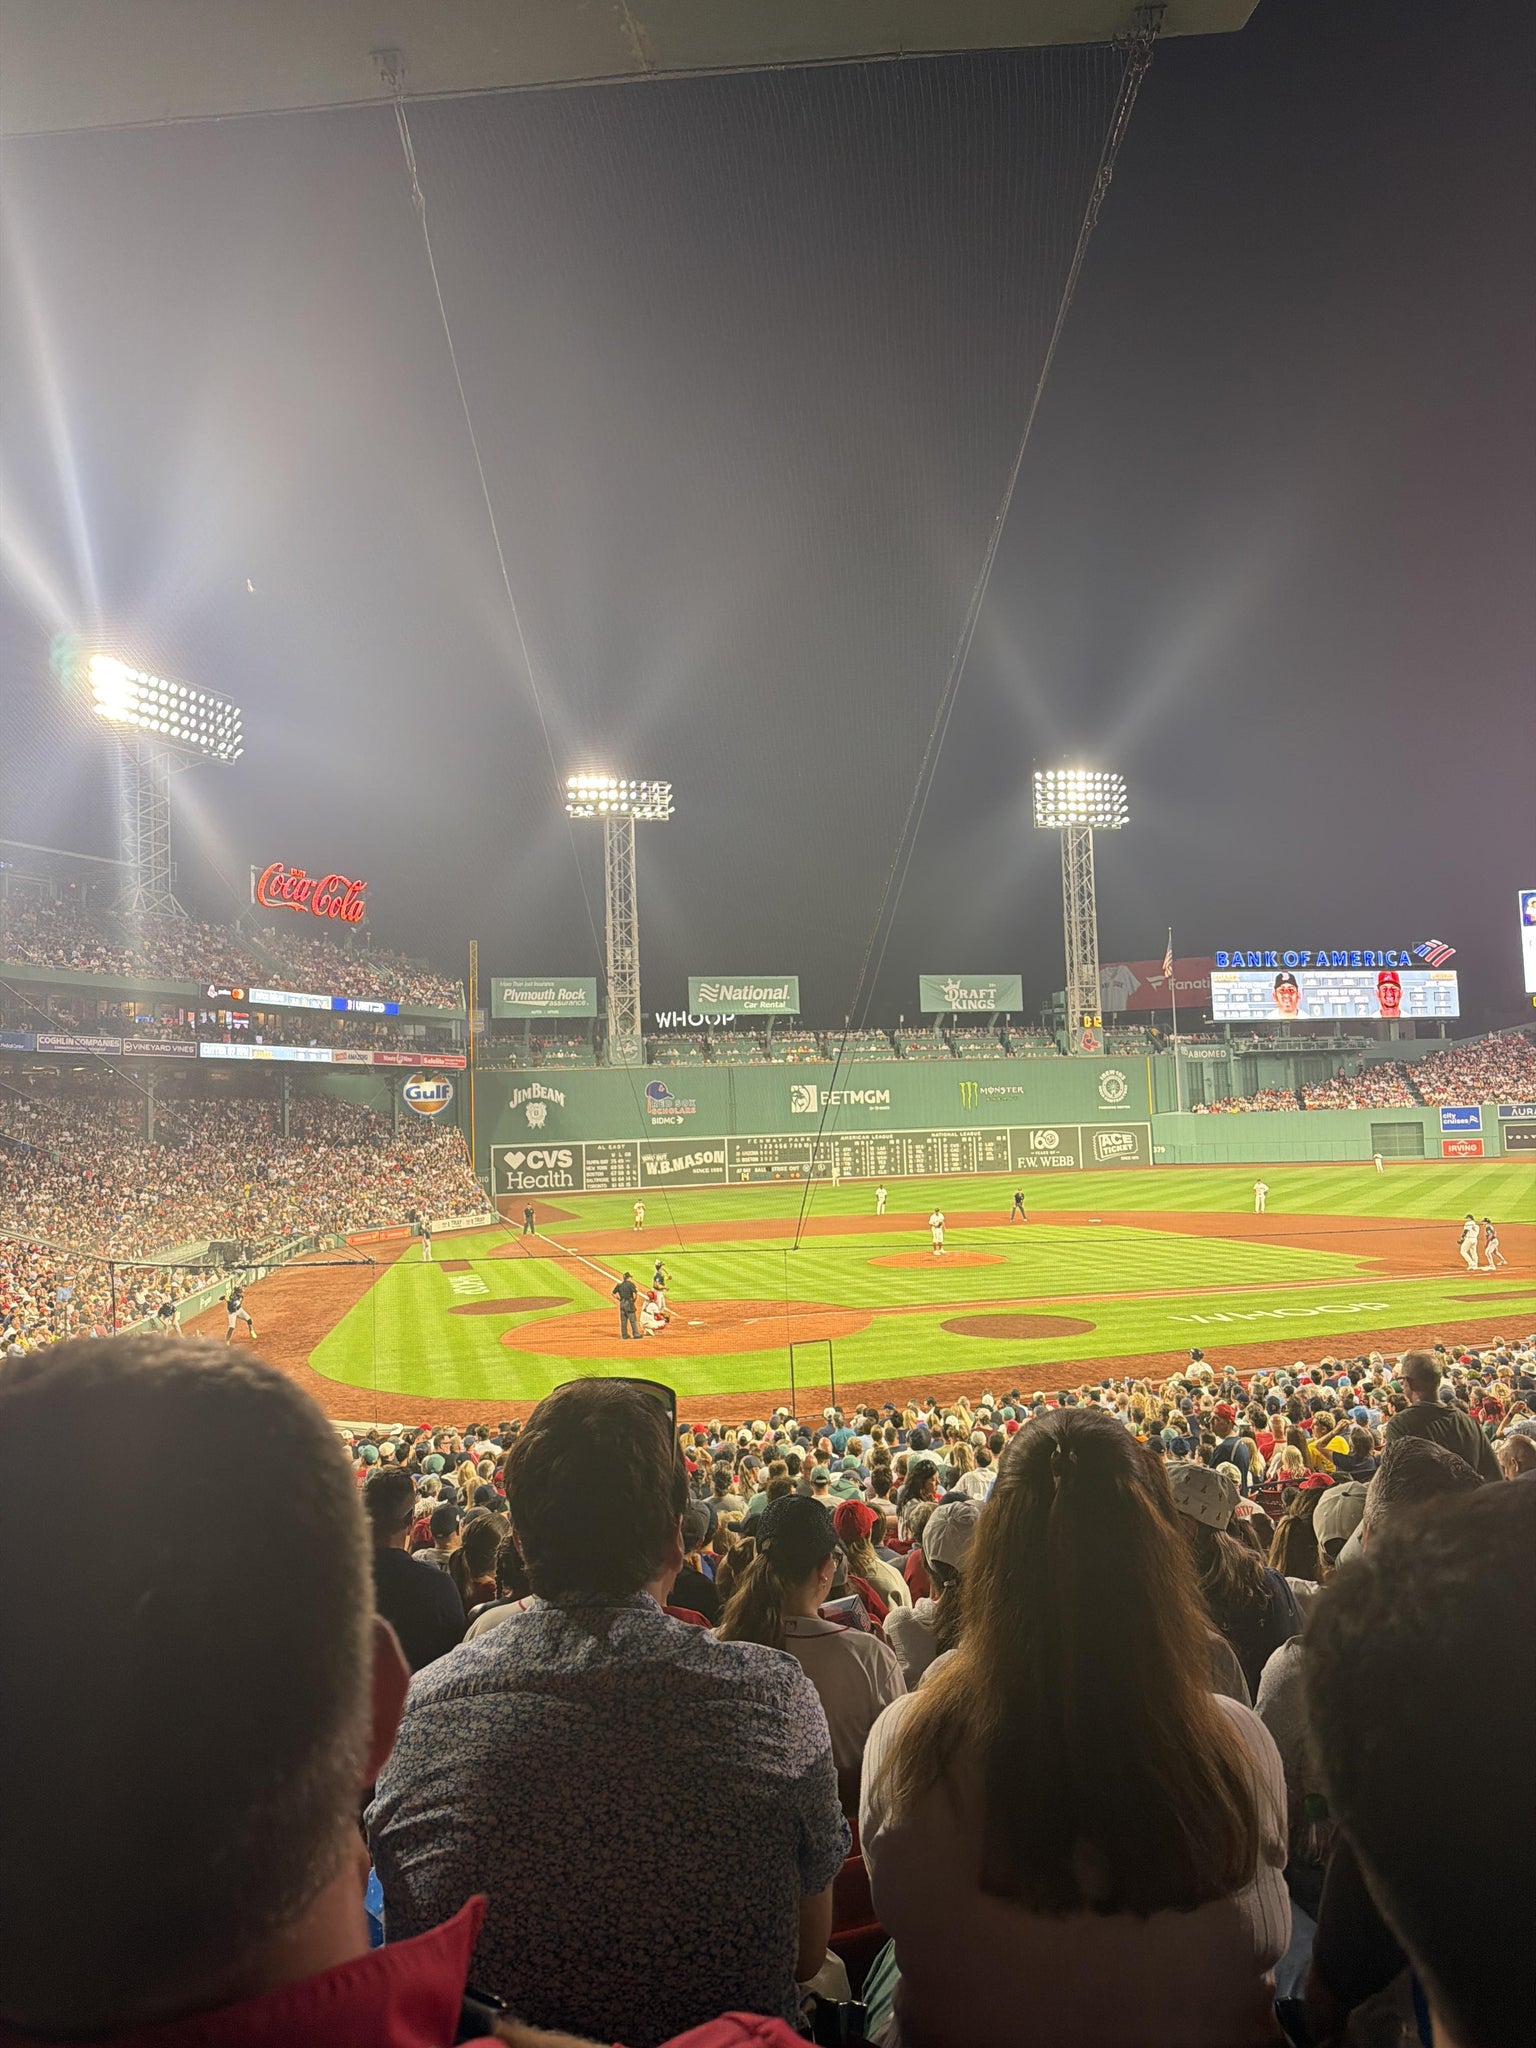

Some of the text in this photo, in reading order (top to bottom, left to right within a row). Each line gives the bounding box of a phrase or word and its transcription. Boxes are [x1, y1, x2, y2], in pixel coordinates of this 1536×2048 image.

[257, 862, 367, 922] Coca-Cola
[1216, 950, 1412, 967] BANK OF AMERICA
[1168, 977, 1210, 990] Fanati
[504, 988, 586, 1001] Plymouth Rock
[719, 984, 788, 1000] National
[945, 987, 997, 1001] DRAFT
[744, 1001, 758, 1009] Car
[952, 1000, 996, 1010] KINGS
[655, 1010, 735, 1029] WHOOP
[39, 1036, 120, 1048] COGHLIN COMPANIES
[132, 1043, 195, 1053] VINEYARD VINES
[1188, 1050, 1226, 1058] ABIOMED
[405, 1084, 450, 1100] Gulf
[509, 1083, 565, 1109] JIM BEAM
[820, 1090, 890, 1105] BETMGM
[980, 1086, 1025, 1096] MONSTER
[651, 1117, 676, 1125] BIDMC
[1442, 1112, 1457, 1120] city
[1029, 1130, 1059, 1150] 160
[1102, 1133, 1133, 1146] ACE
[1103, 1144, 1133, 1155] TICKET
[1448, 1144, 1478, 1152] IRVING
[526, 1149, 573, 1170] CVS
[1018, 1155, 1074, 1168] F.W. WEBB
[506, 1170, 574, 1190] Health
[1167, 1302, 1391, 1324] WHOOP
[1235, 1505, 1254, 1517] RTIZ
